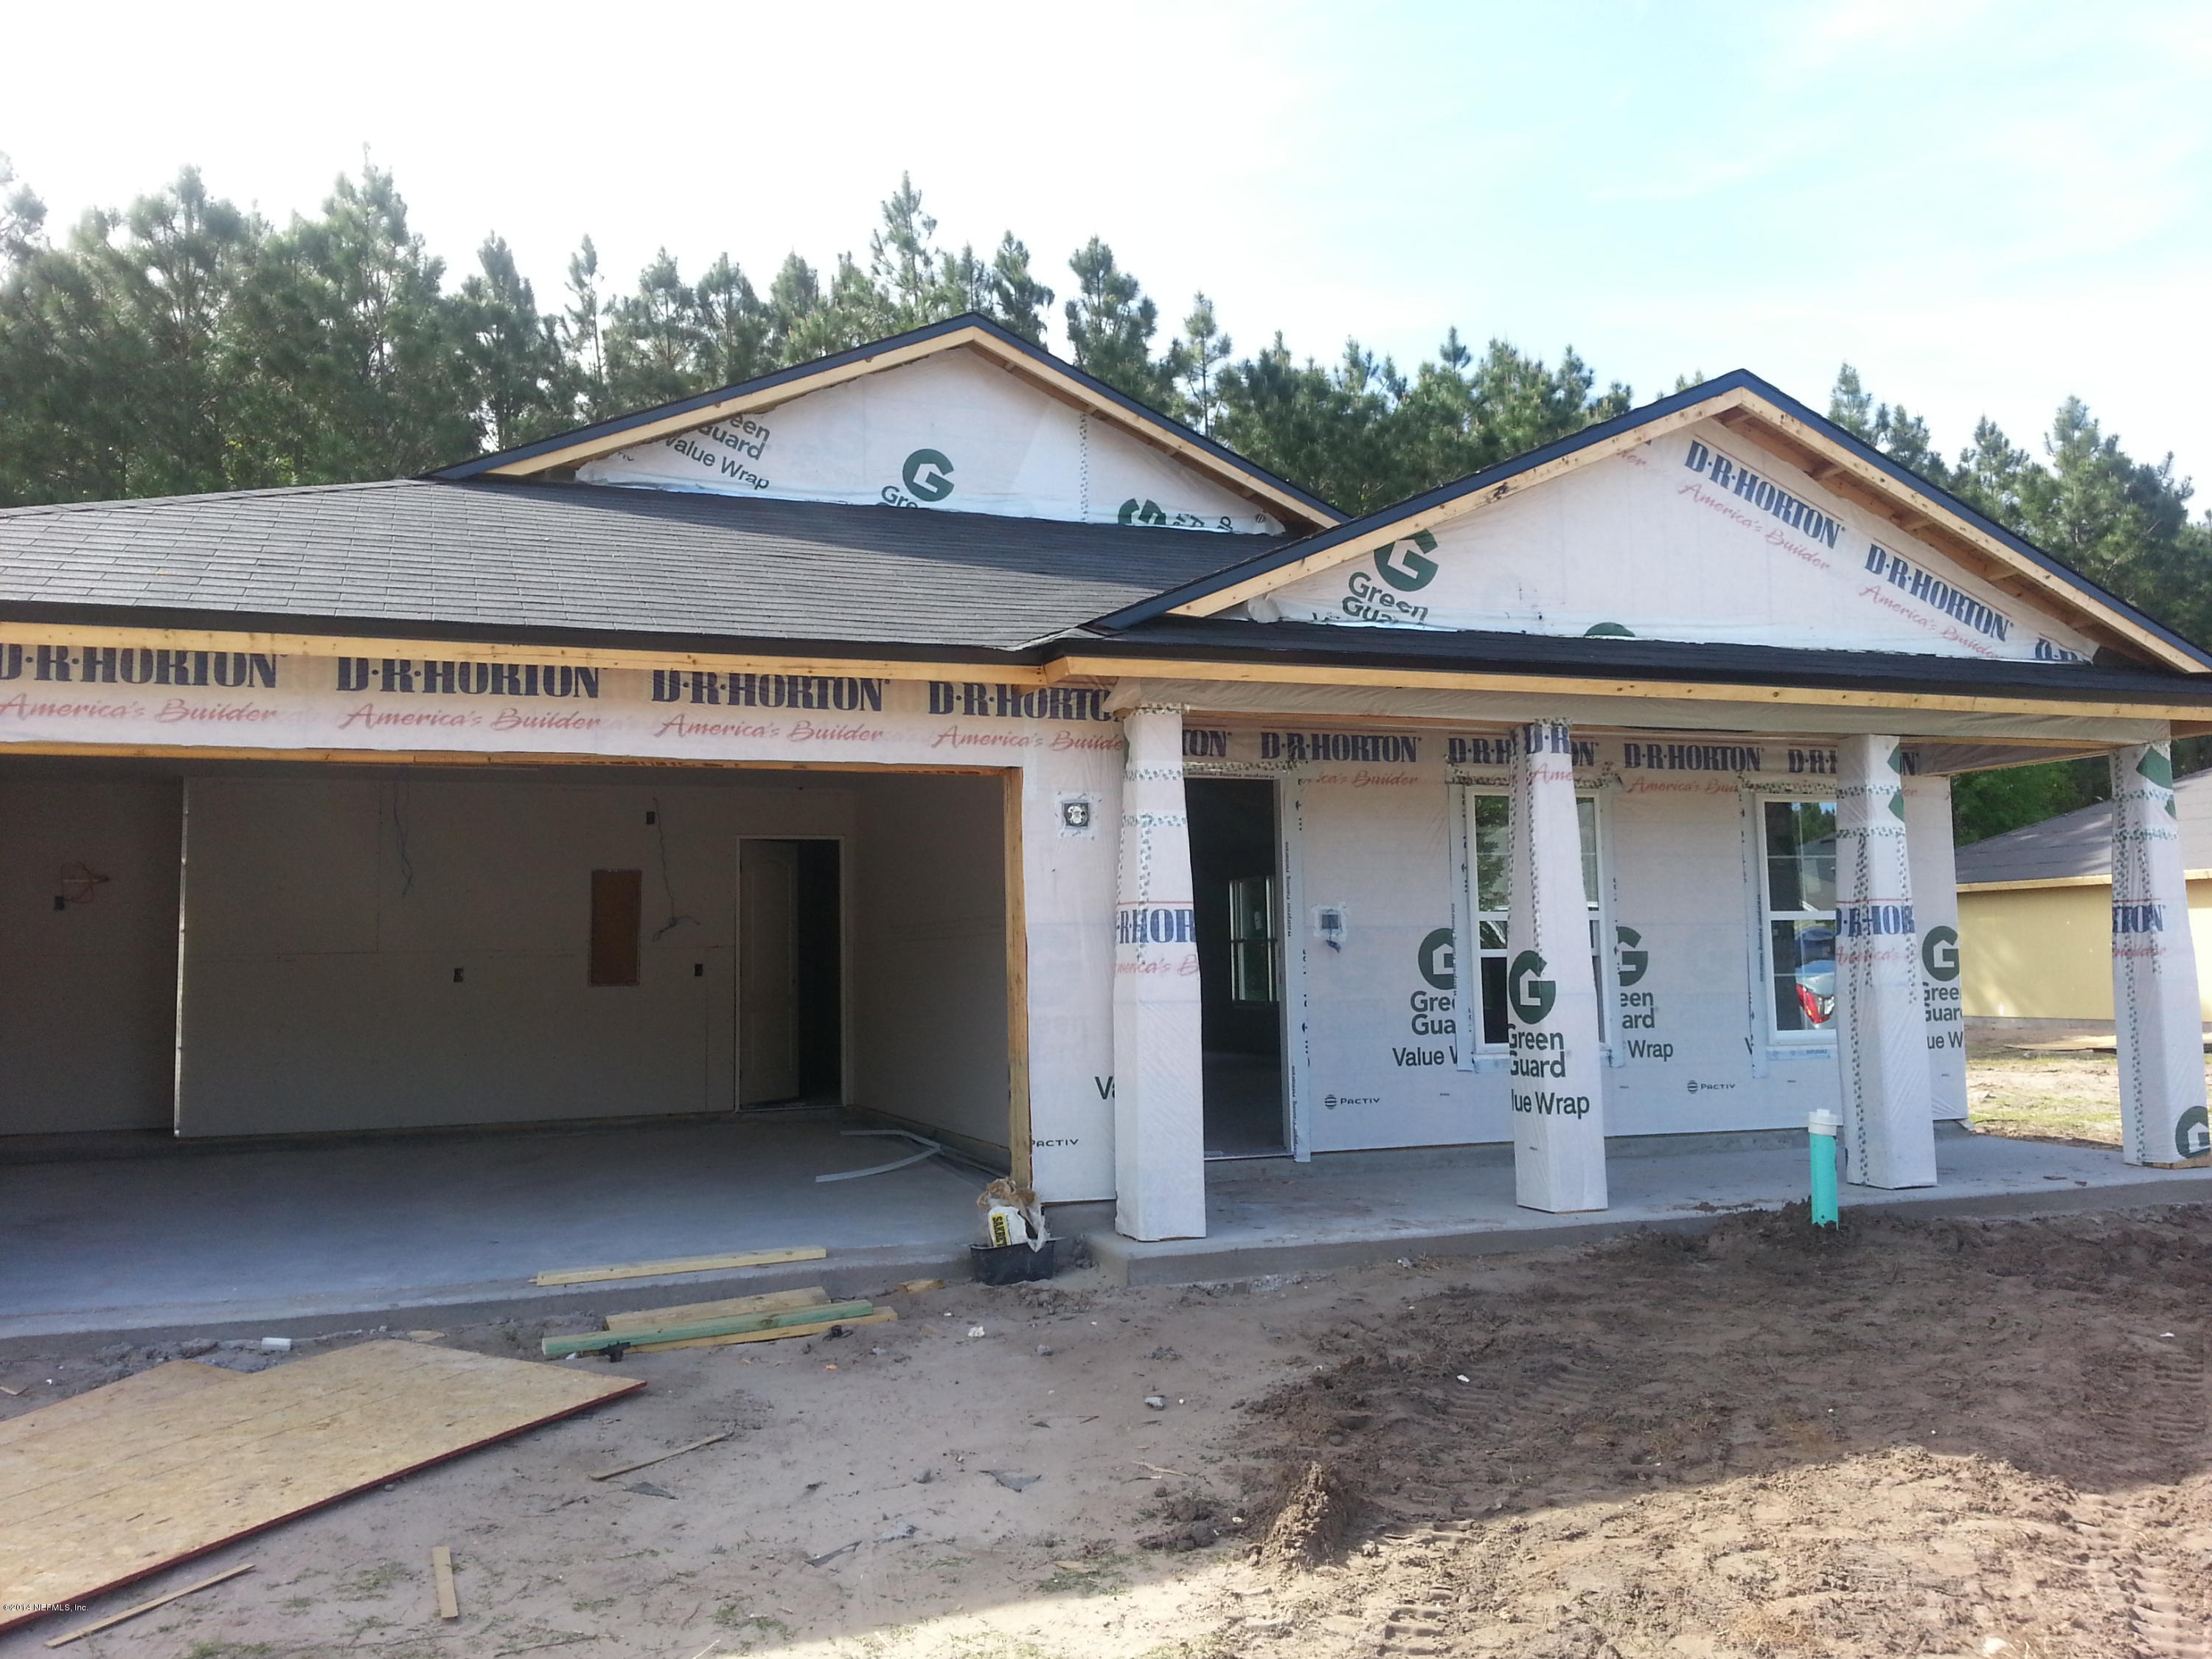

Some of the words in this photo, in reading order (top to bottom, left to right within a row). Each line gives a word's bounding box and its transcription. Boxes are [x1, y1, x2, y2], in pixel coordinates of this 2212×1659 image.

[730, 413, 771, 442] een
[720, 456, 770, 490] Wrap
[902, 448, 955, 502] G
[1677, 483, 1762, 532] America's
[1764, 528, 1831, 569] Builder
[1348, 571, 1429, 622] Green
[1859, 585, 1938, 631] America's
[0, 692, 145, 722] America's
[153, 698, 278, 724] Builder
[338, 703, 484, 731] America's
[490, 707, 602, 731] Builder
[654, 713, 780, 738] America's
[786, 720, 884, 742] Builder
[931, 725, 1043, 749] America's
[1048, 730, 1125, 752] Builde
[1352, 769, 1419, 787] Builder
[1626, 776, 1700, 793] America's
[1410, 990, 1455, 1013] Gre
[1508, 950, 1557, 1025] G
[1620, 992, 1654, 1007] een
[1411, 1014, 1456, 1035] Gua
[1622, 1007, 1655, 1030] ard
[1508, 1023, 1565, 1051] Green
[1627, 1039, 1674, 1062] Wrap
[1392, 1046, 1445, 1067] Value
[1510, 1051, 1566, 1078] Guard
[1511, 1088, 1532, 1113] lue
[1534, 1091, 1590, 1120] Wrap
